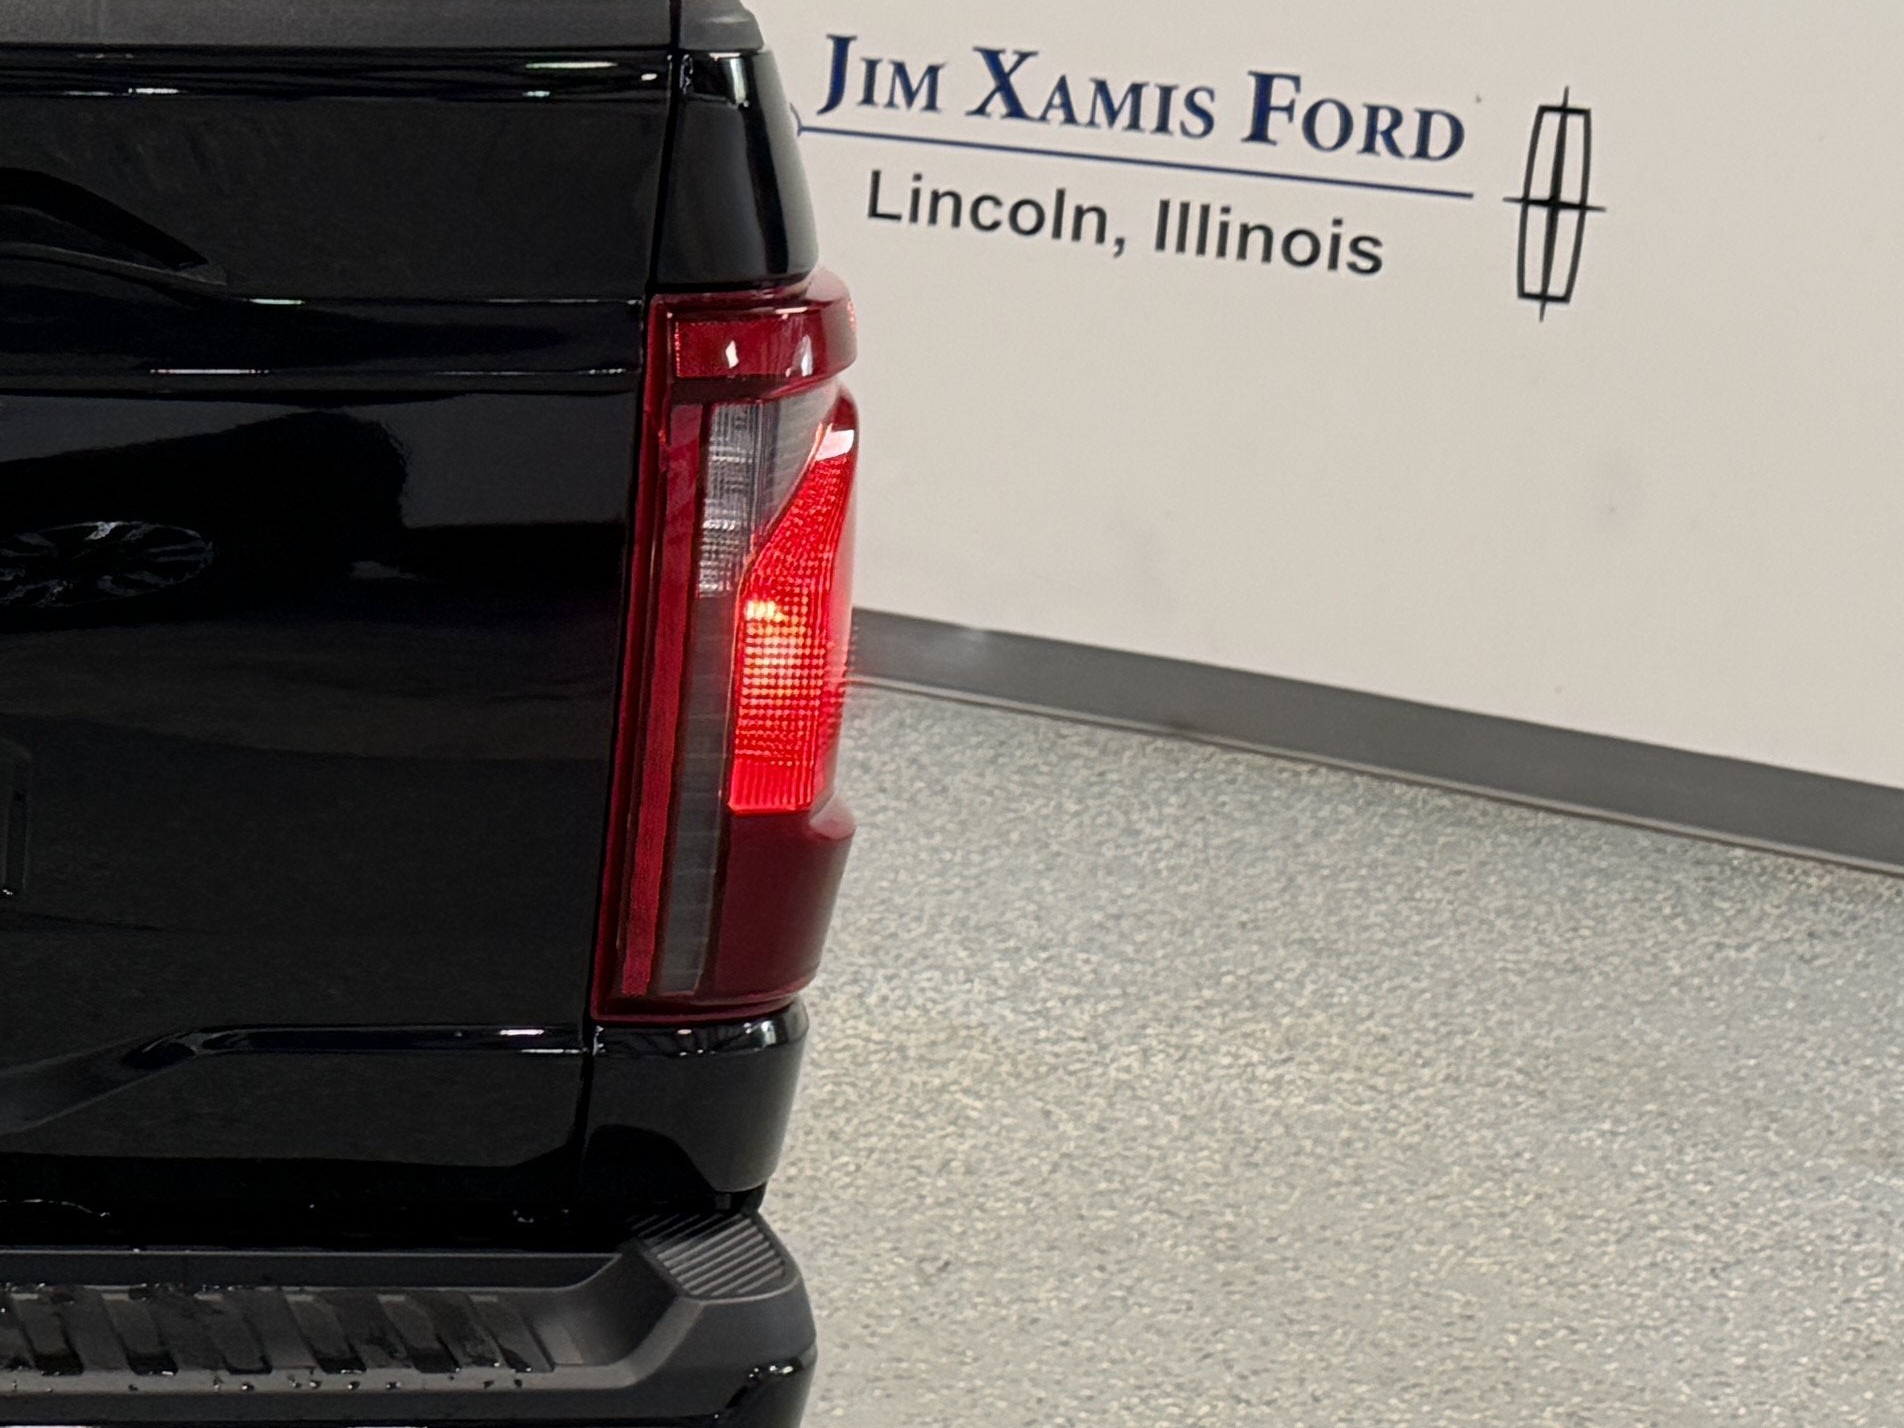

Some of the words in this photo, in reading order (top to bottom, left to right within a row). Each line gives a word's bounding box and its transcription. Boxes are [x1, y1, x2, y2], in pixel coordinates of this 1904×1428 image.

[816, 34, 947, 116] JIM
[964, 46, 1216, 139] XAMIS
[1241, 70, 1465, 162] FORD
[867, 169, 1126, 258] Lincoln,
[1154, 199, 1383, 276] Illinois
